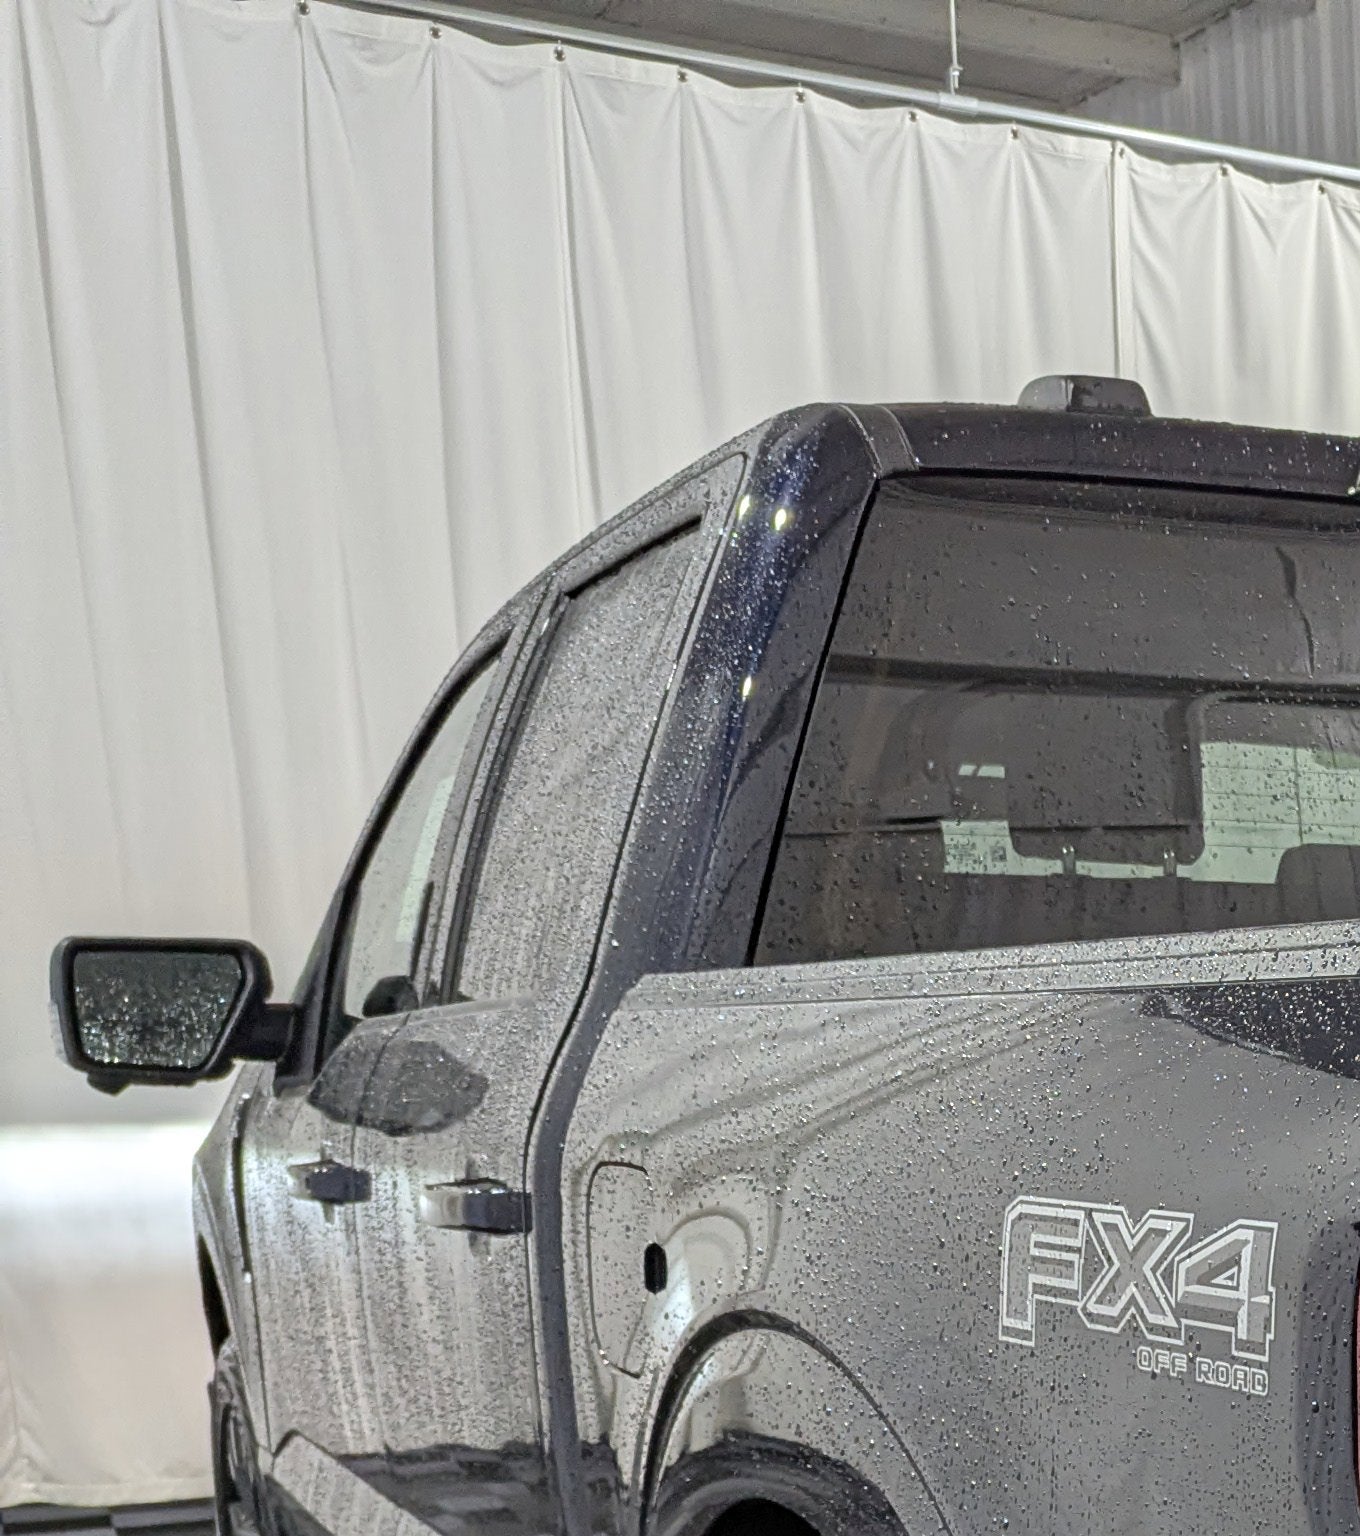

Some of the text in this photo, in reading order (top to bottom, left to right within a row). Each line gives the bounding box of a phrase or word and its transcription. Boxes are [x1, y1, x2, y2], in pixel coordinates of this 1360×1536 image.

[999, 1195, 1279, 1362] FX4
[1137, 1346, 1270, 1396] OFF ROAD
